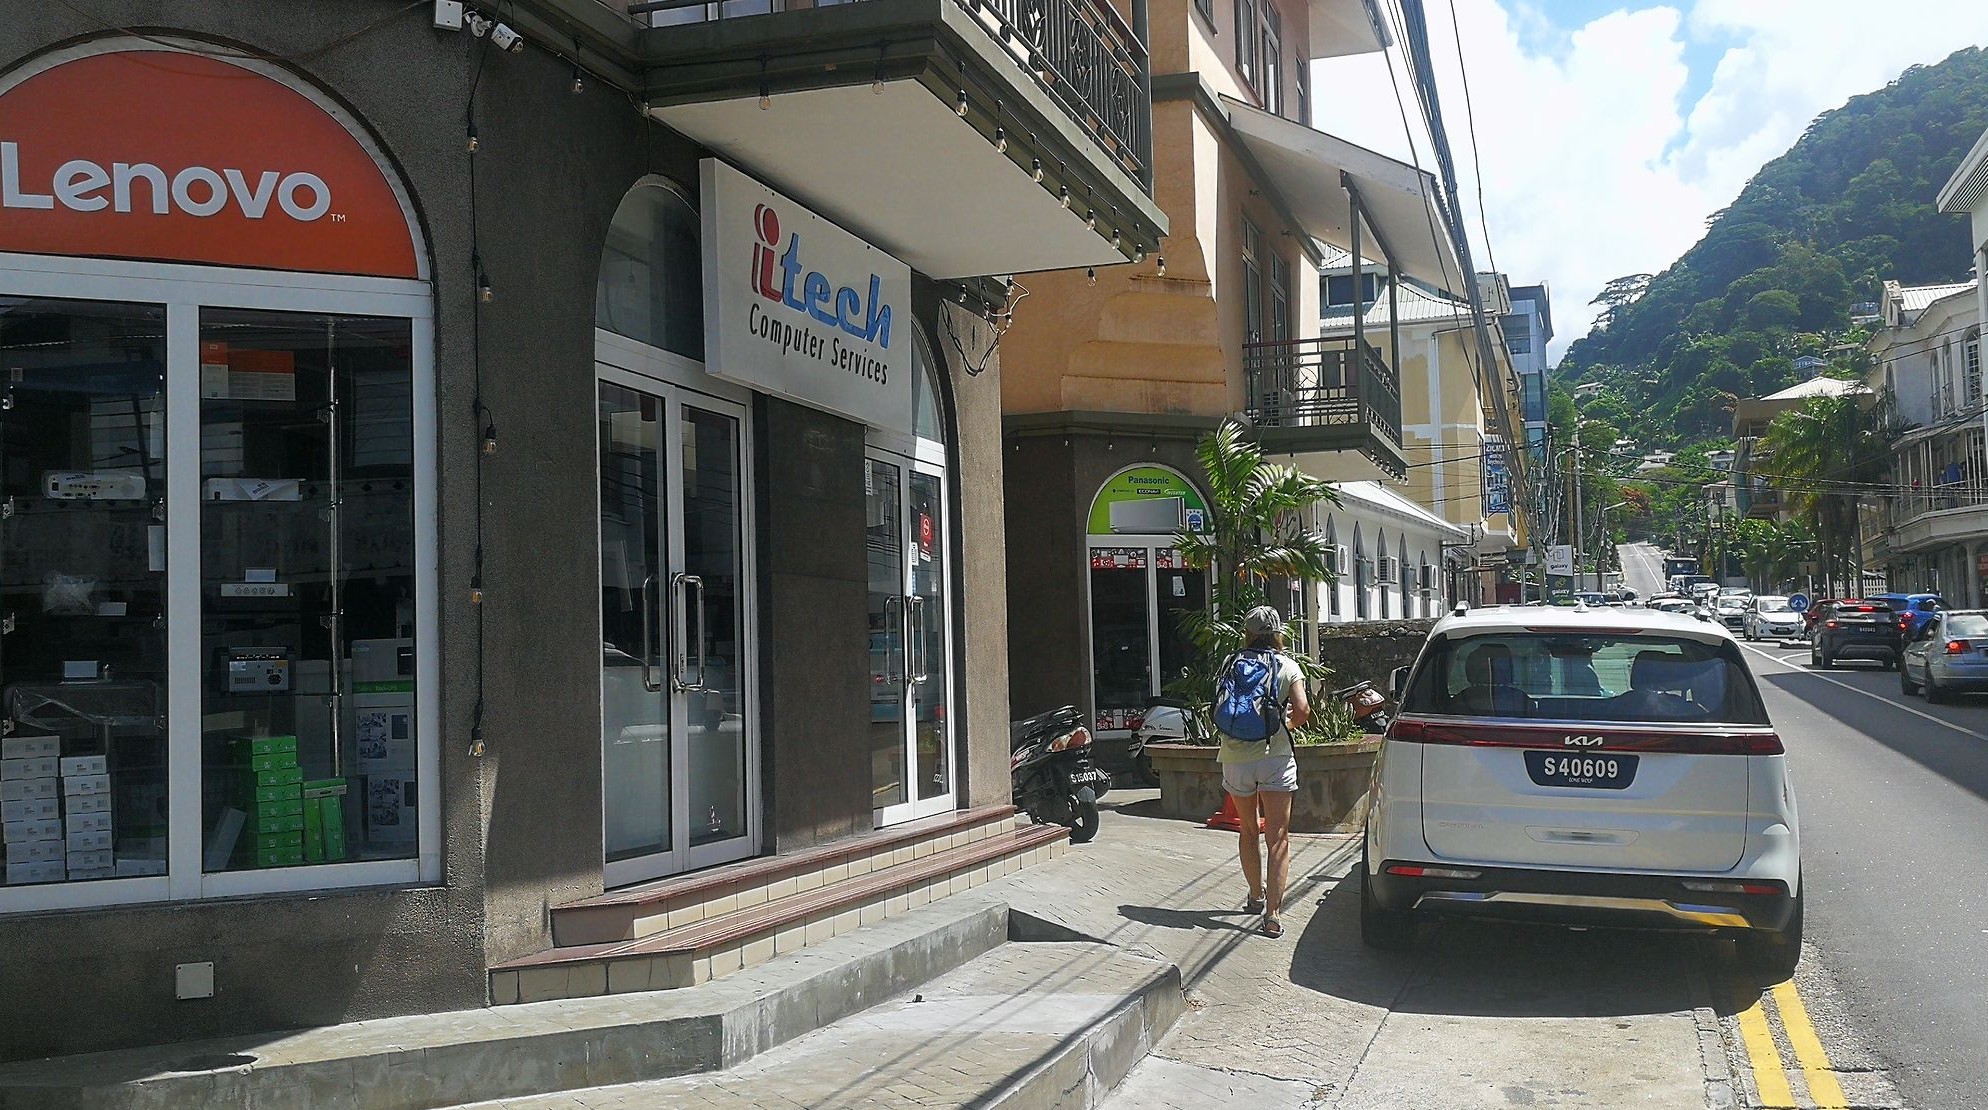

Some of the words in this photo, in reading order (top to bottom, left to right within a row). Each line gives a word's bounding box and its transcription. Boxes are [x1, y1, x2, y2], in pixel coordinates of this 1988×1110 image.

[1, 141, 331, 220] Lenovo
[751, 203, 893, 349] itech
[749, 303, 825, 360] Computer
[831, 337, 888, 385] Services
[1128, 476, 1170, 485] Panasonic
[1551, 588, 1570, 596] galaxy
[1564, 735, 1604, 746] KIA
[1070, 771, 1097, 783] S15037
